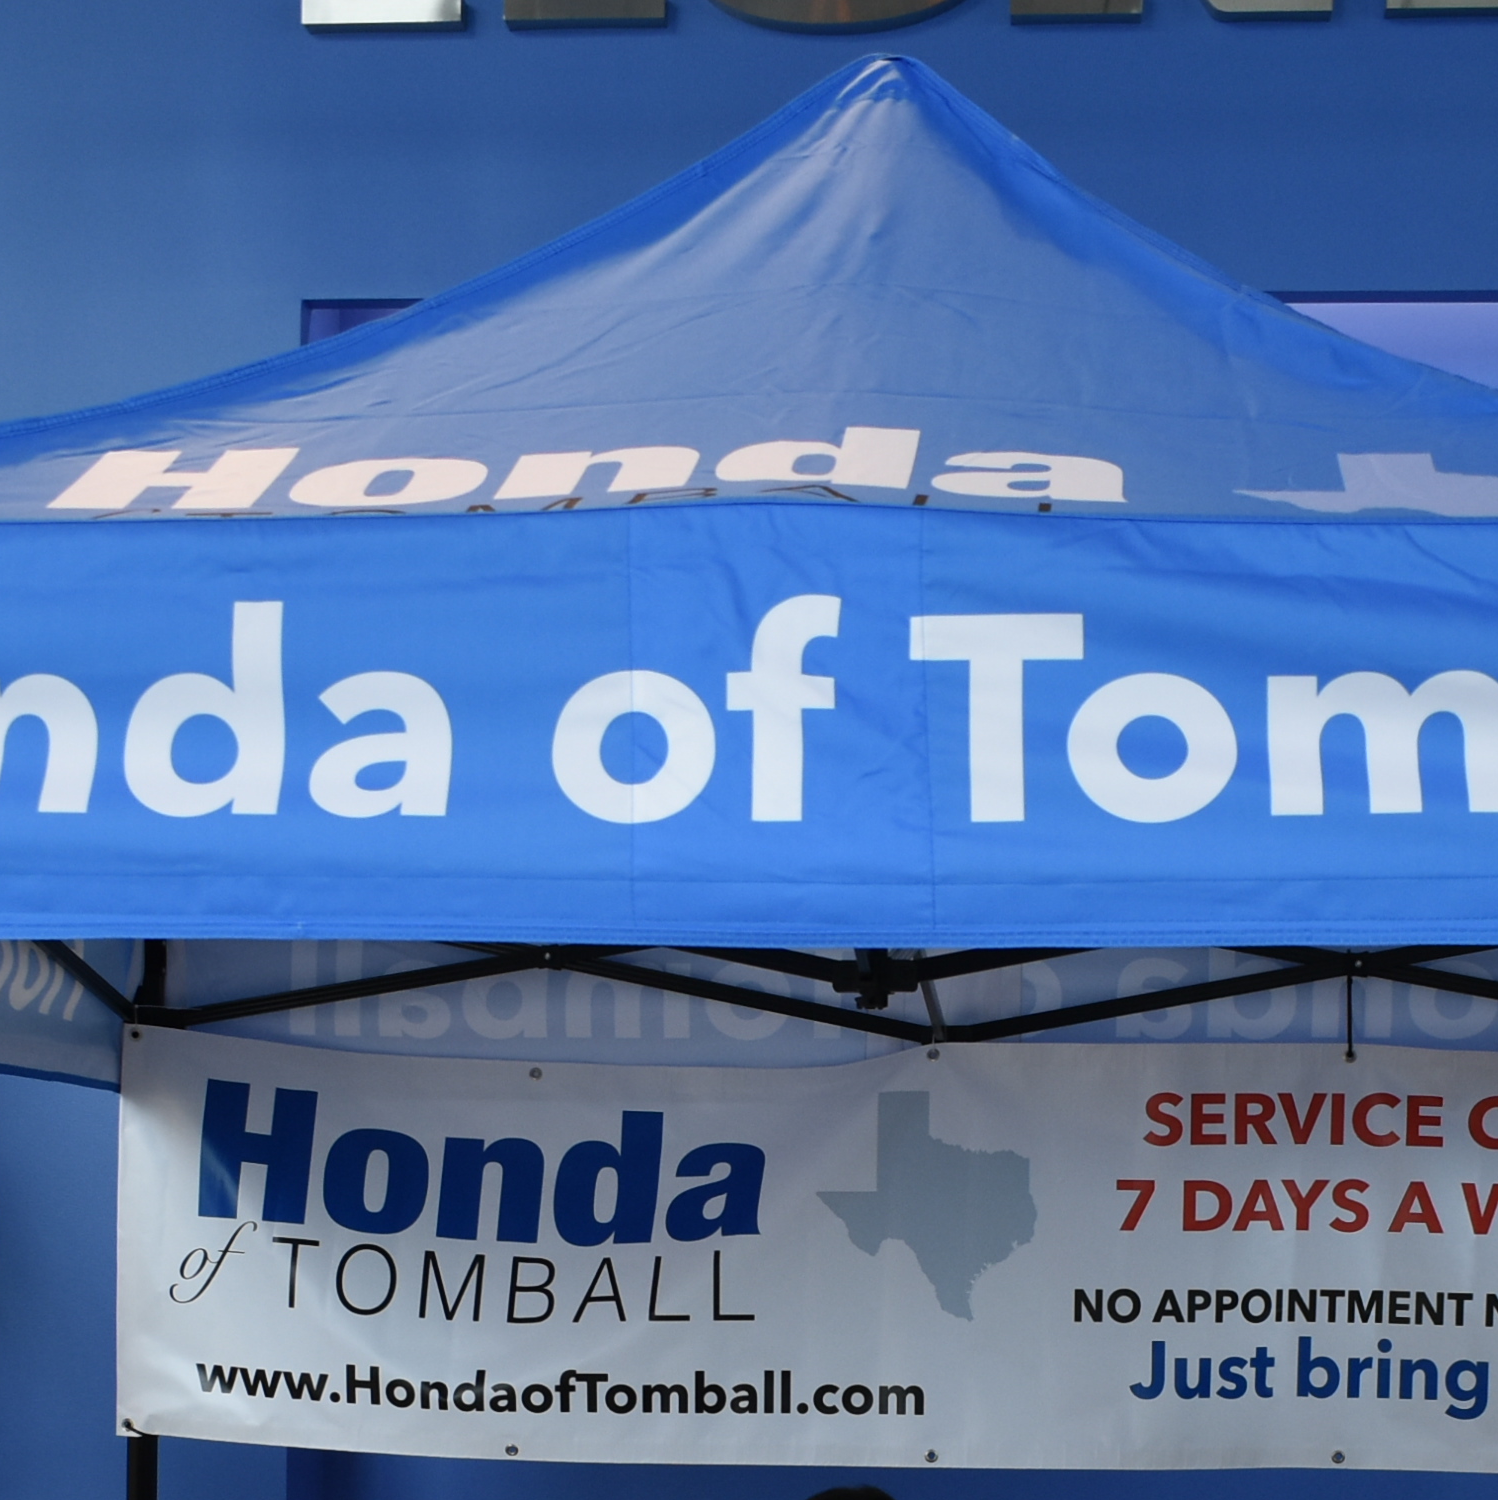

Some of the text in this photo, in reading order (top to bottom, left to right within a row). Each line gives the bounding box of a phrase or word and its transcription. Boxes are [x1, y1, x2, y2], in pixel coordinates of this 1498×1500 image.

[47, 425, 1128, 512] Honda
[550, 595, 843, 825] of
[197, 1077, 767, 1247] Honda
[1142, 1091, 1445, 1149] SERVICE
[1114, 1178, 1157, 1232] 7
[1181, 1178, 1370, 1233] DAYS
[1387, 1180, 1444, 1234] A
[168, 1220, 757, 1324] of TOMBALL
[1072, 1288, 1143, 1324] NO
[1152, 1289, 1474, 1328] APPOINTMENT
[195, 1360, 926, 1417] www.HondaofTomball.com
[1128, 1340, 1275, 1401] Just
[1297, 1336, 1491, 1421] bring
